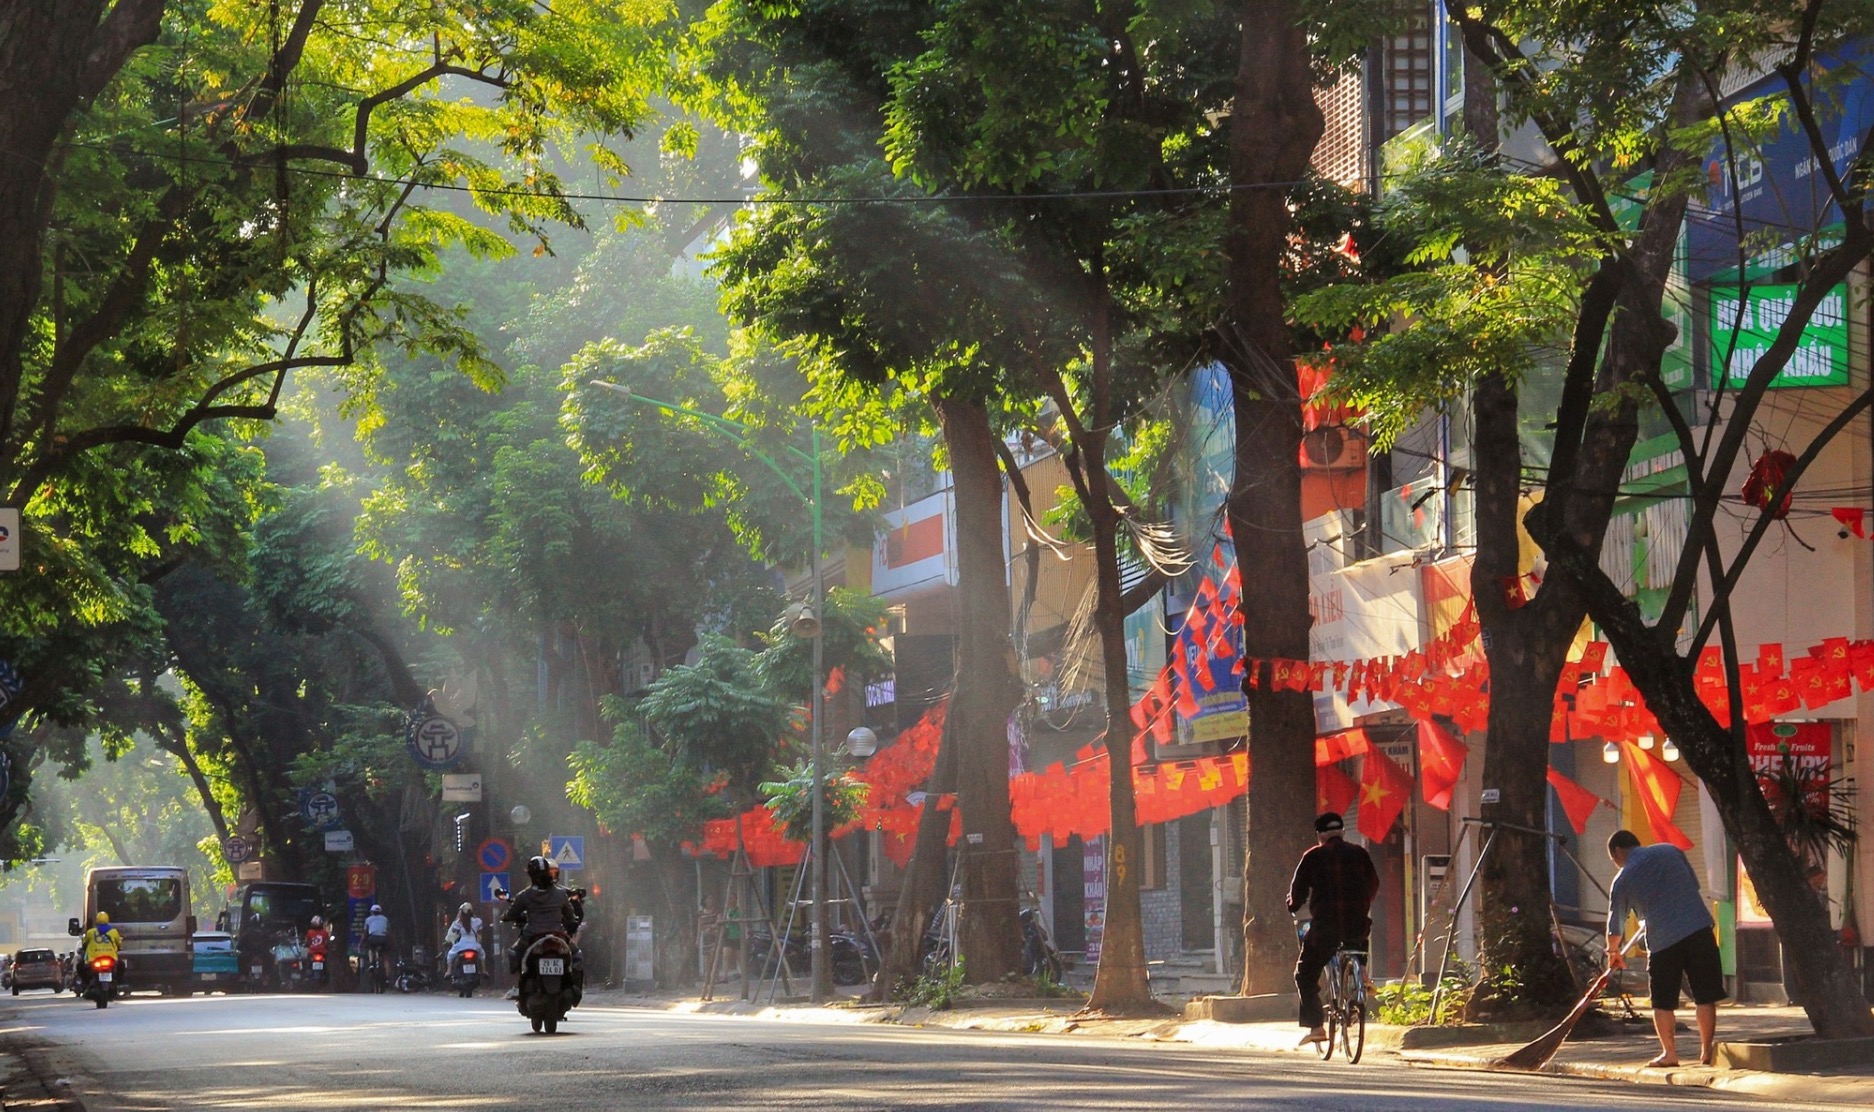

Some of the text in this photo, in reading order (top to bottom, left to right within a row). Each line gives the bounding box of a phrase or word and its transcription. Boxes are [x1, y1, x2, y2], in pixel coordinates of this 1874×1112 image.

[1845, 136, 1858, 158] DÂN
[1717, 299, 1754, 331] HOA
[1758, 290, 1795, 333] QUẢ
[1754, 742, 1815, 752] Fresh Fruits
